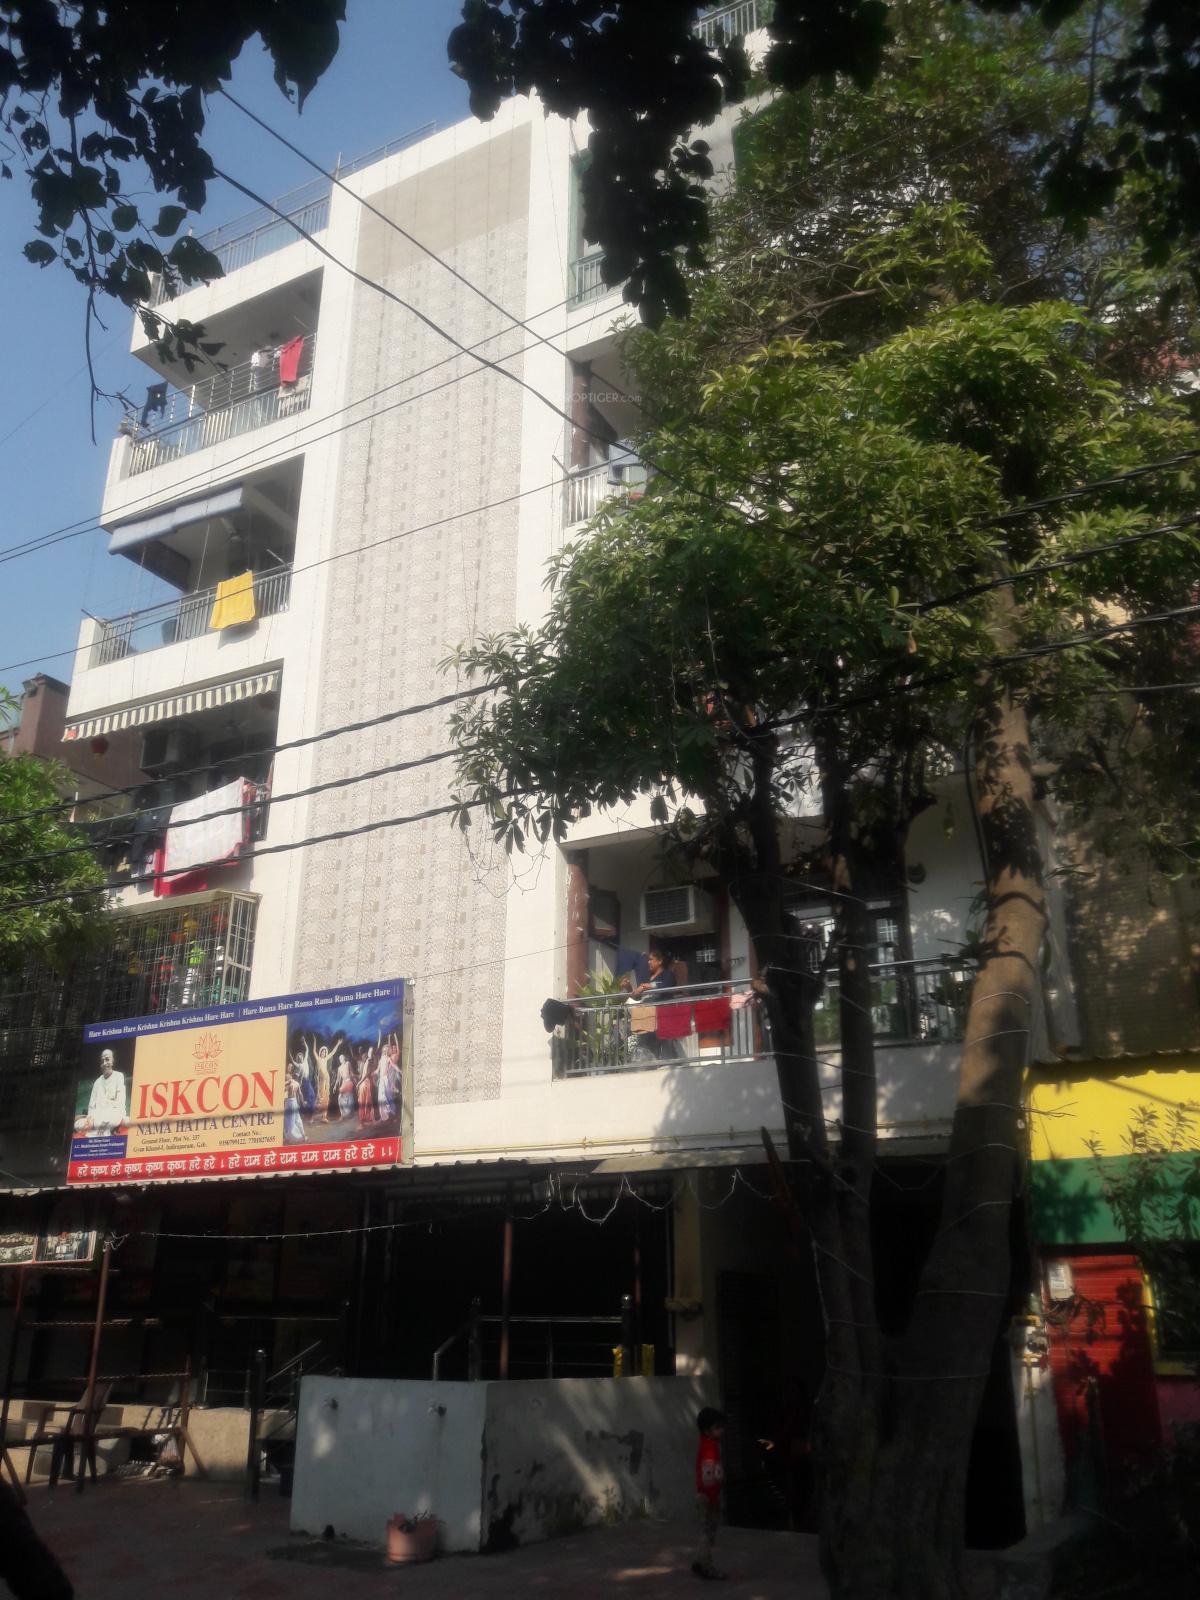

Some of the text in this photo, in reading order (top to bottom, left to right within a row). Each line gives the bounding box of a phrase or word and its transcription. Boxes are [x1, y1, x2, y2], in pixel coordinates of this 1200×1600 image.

[88, 1030, 102, 1038] Hare
[102, 1028, 122, 1036] Krishna
[137, 1023, 158, 1031] Krishna
[159, 1019, 181, 1028] Krishna
[182, 1016, 204, 1025] Krishna
[204, 1013, 219, 1021] Hare
[220, 1011, 235, 1019] Hare
[242, 1008, 257, 1016] Hare
[258, 1006, 276, 1014] Rama
[278, 1002, 293, 1010] Hare
[295, 1000, 313, 1008] Rama
[314, 998, 333, 1006] Rama
[334, 994, 354, 1003] Rama
[356, 991, 372, 1000] Hare
[374, 988, 391, 998] Hare
[136, 1070, 279, 1119] ISKCON
[136, 1112, 275, 1136] NAMA HATTA CENTRE
[78, 1163, 88, 1178] हरे
[90, 1165, 109, 1180] कृष्ण
[110, 1162, 122, 1176] हरे
[124, 1163, 143, 1178] कृष्ण
[145, 1161, 164, 1176] कृष्ण
[166, 1160, 187, 1176] कृष्ण
[188, 1156, 201, 1170] हरे
[203, 1155, 216, 1170] हरे
[228, 1153, 241, 1169] हरे
[244, 1155, 260, 1167] राम
[264, 1151, 277, 1167] हरे
[280, 1152, 298, 1164] राम
[301, 1150, 320, 1163] राम
[322, 1148, 342, 1162] राम
[344, 1145, 358, 1161] हरे
[361, 1143, 375, 1160] हरे
